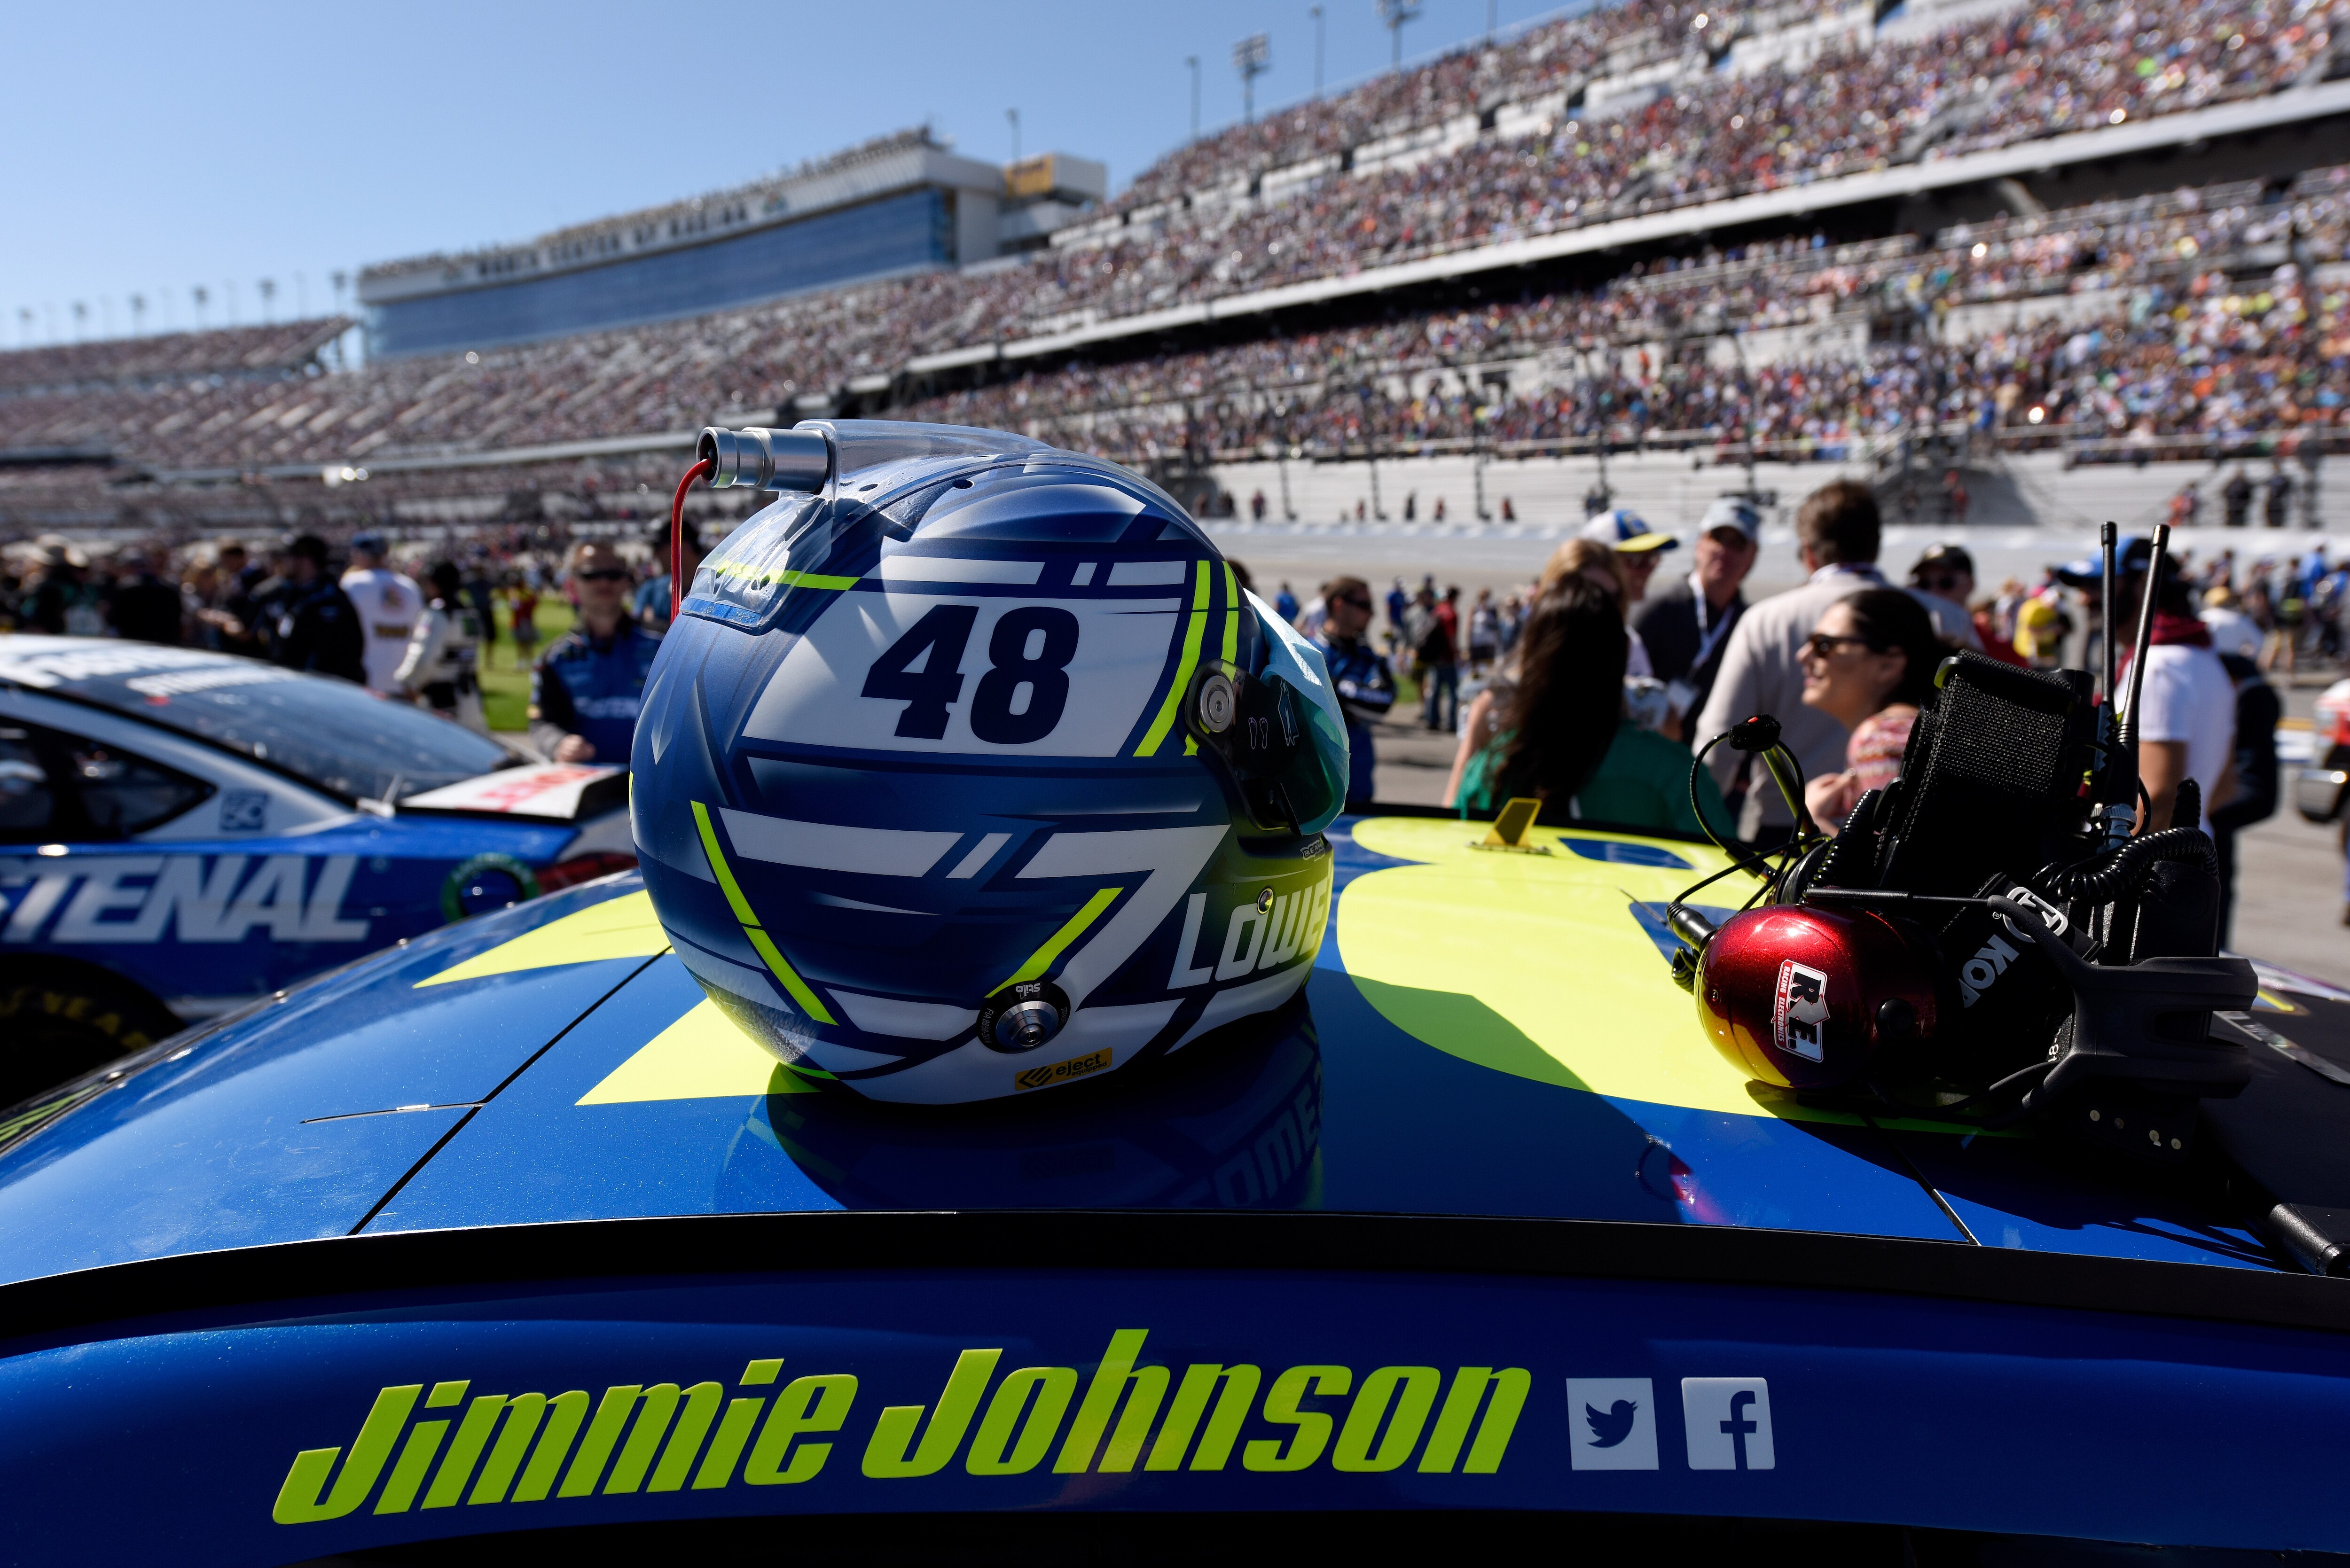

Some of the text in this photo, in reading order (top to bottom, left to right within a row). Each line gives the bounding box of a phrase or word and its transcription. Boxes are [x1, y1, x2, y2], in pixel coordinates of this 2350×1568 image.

[860, 604, 1080, 744] 48
[1015, 983, 1041, 999] Stilo
[1778, 966, 1790, 1043] RACING ELECTRONICS
[981, 1008, 994, 1044] FIA 8858-2010
[1056, 1053, 1101, 1076] eject
[1072, 1061, 1107, 1076] equipped
[273, 1329, 1532, 1525] Jimmie Johnson
